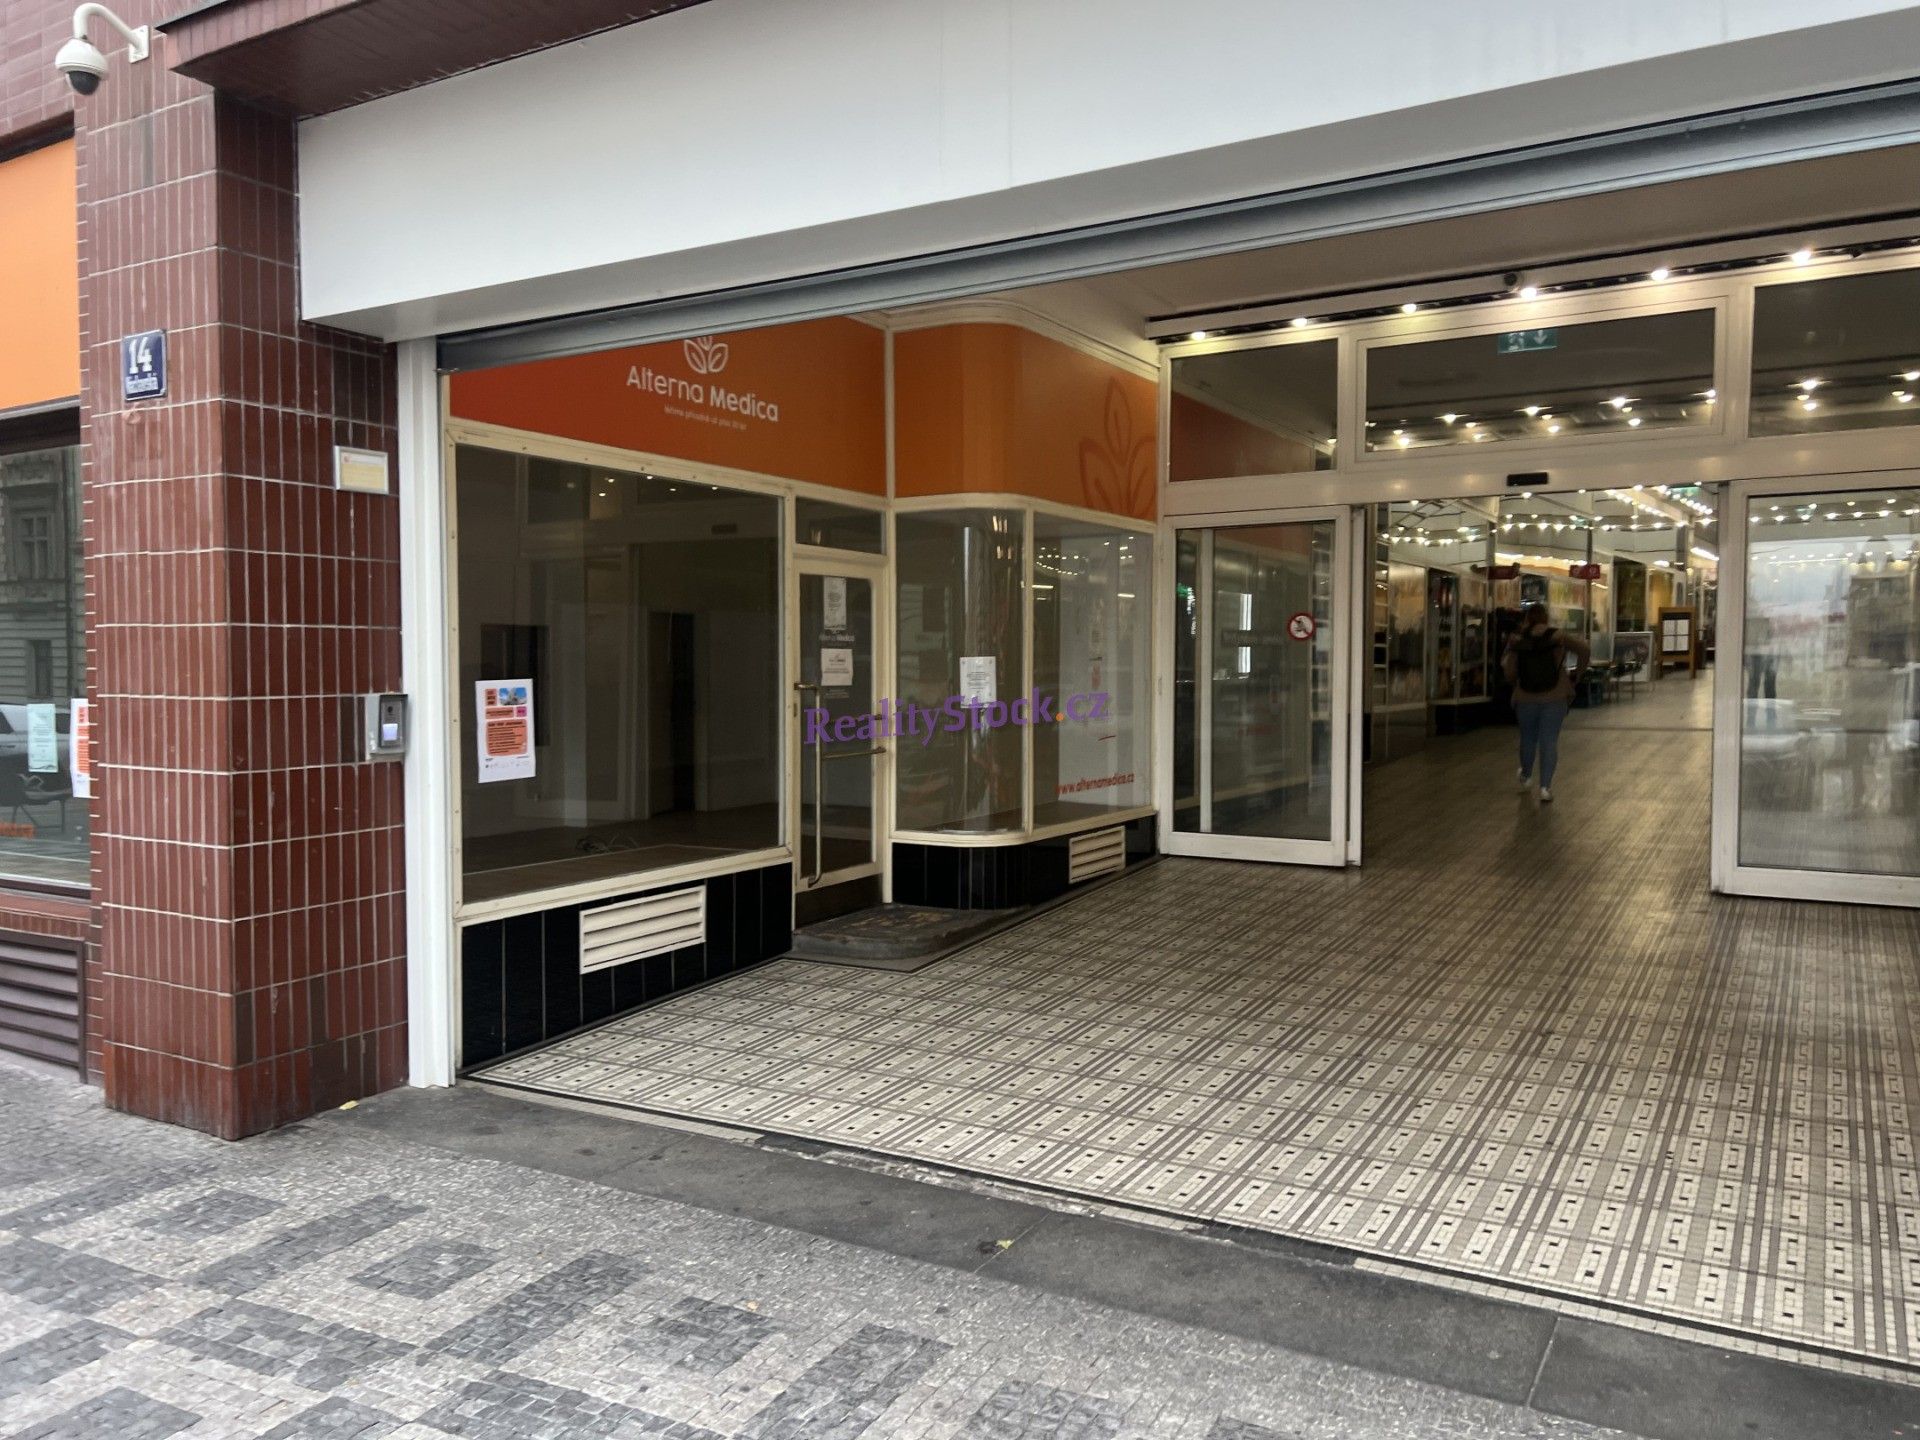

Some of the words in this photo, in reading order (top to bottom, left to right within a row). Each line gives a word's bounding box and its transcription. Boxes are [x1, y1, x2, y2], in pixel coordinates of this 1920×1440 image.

[129, 337, 153, 374] 14
[626, 365, 705, 404] Alterna
[710, 385, 779, 422] Medica
